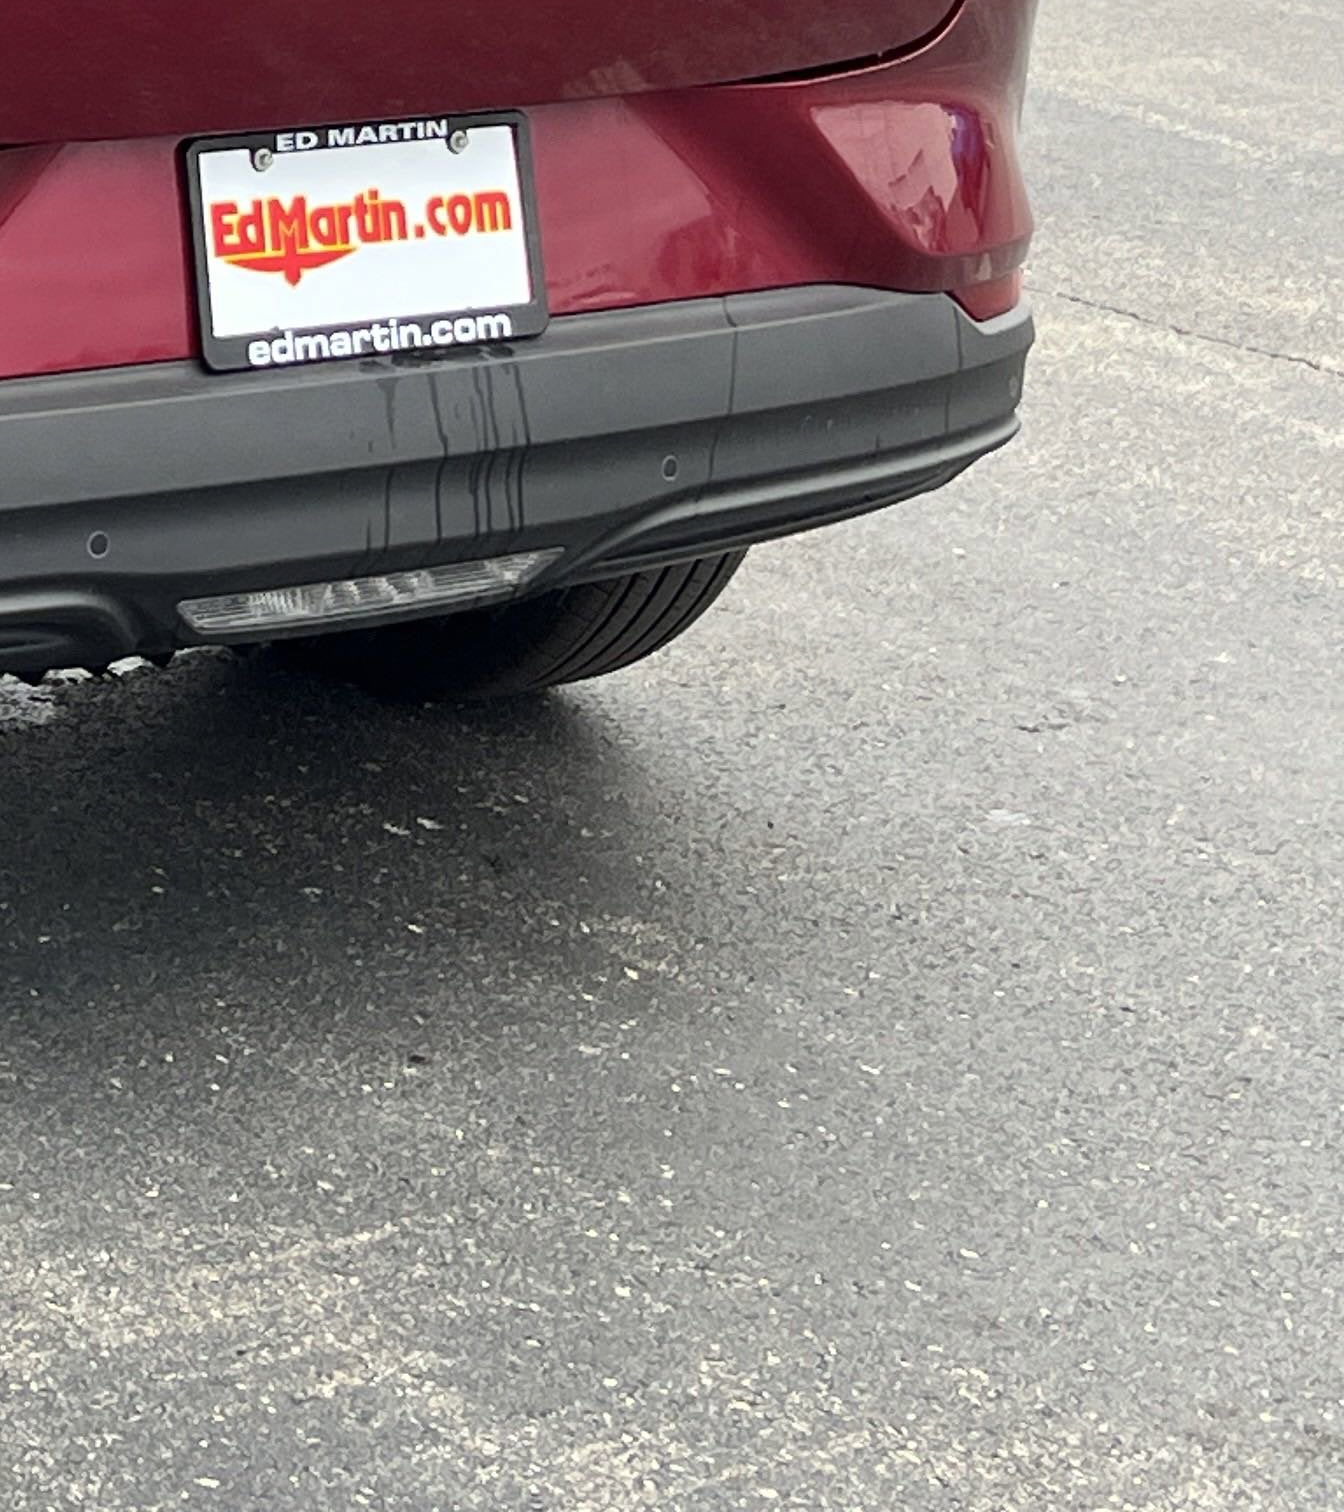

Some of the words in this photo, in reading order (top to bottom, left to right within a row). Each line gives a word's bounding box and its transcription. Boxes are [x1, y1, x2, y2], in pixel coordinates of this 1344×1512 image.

[276, 131, 319, 152] ED
[327, 119, 448, 147] MARTIN
[248, 311, 511, 366] edmartin.com
